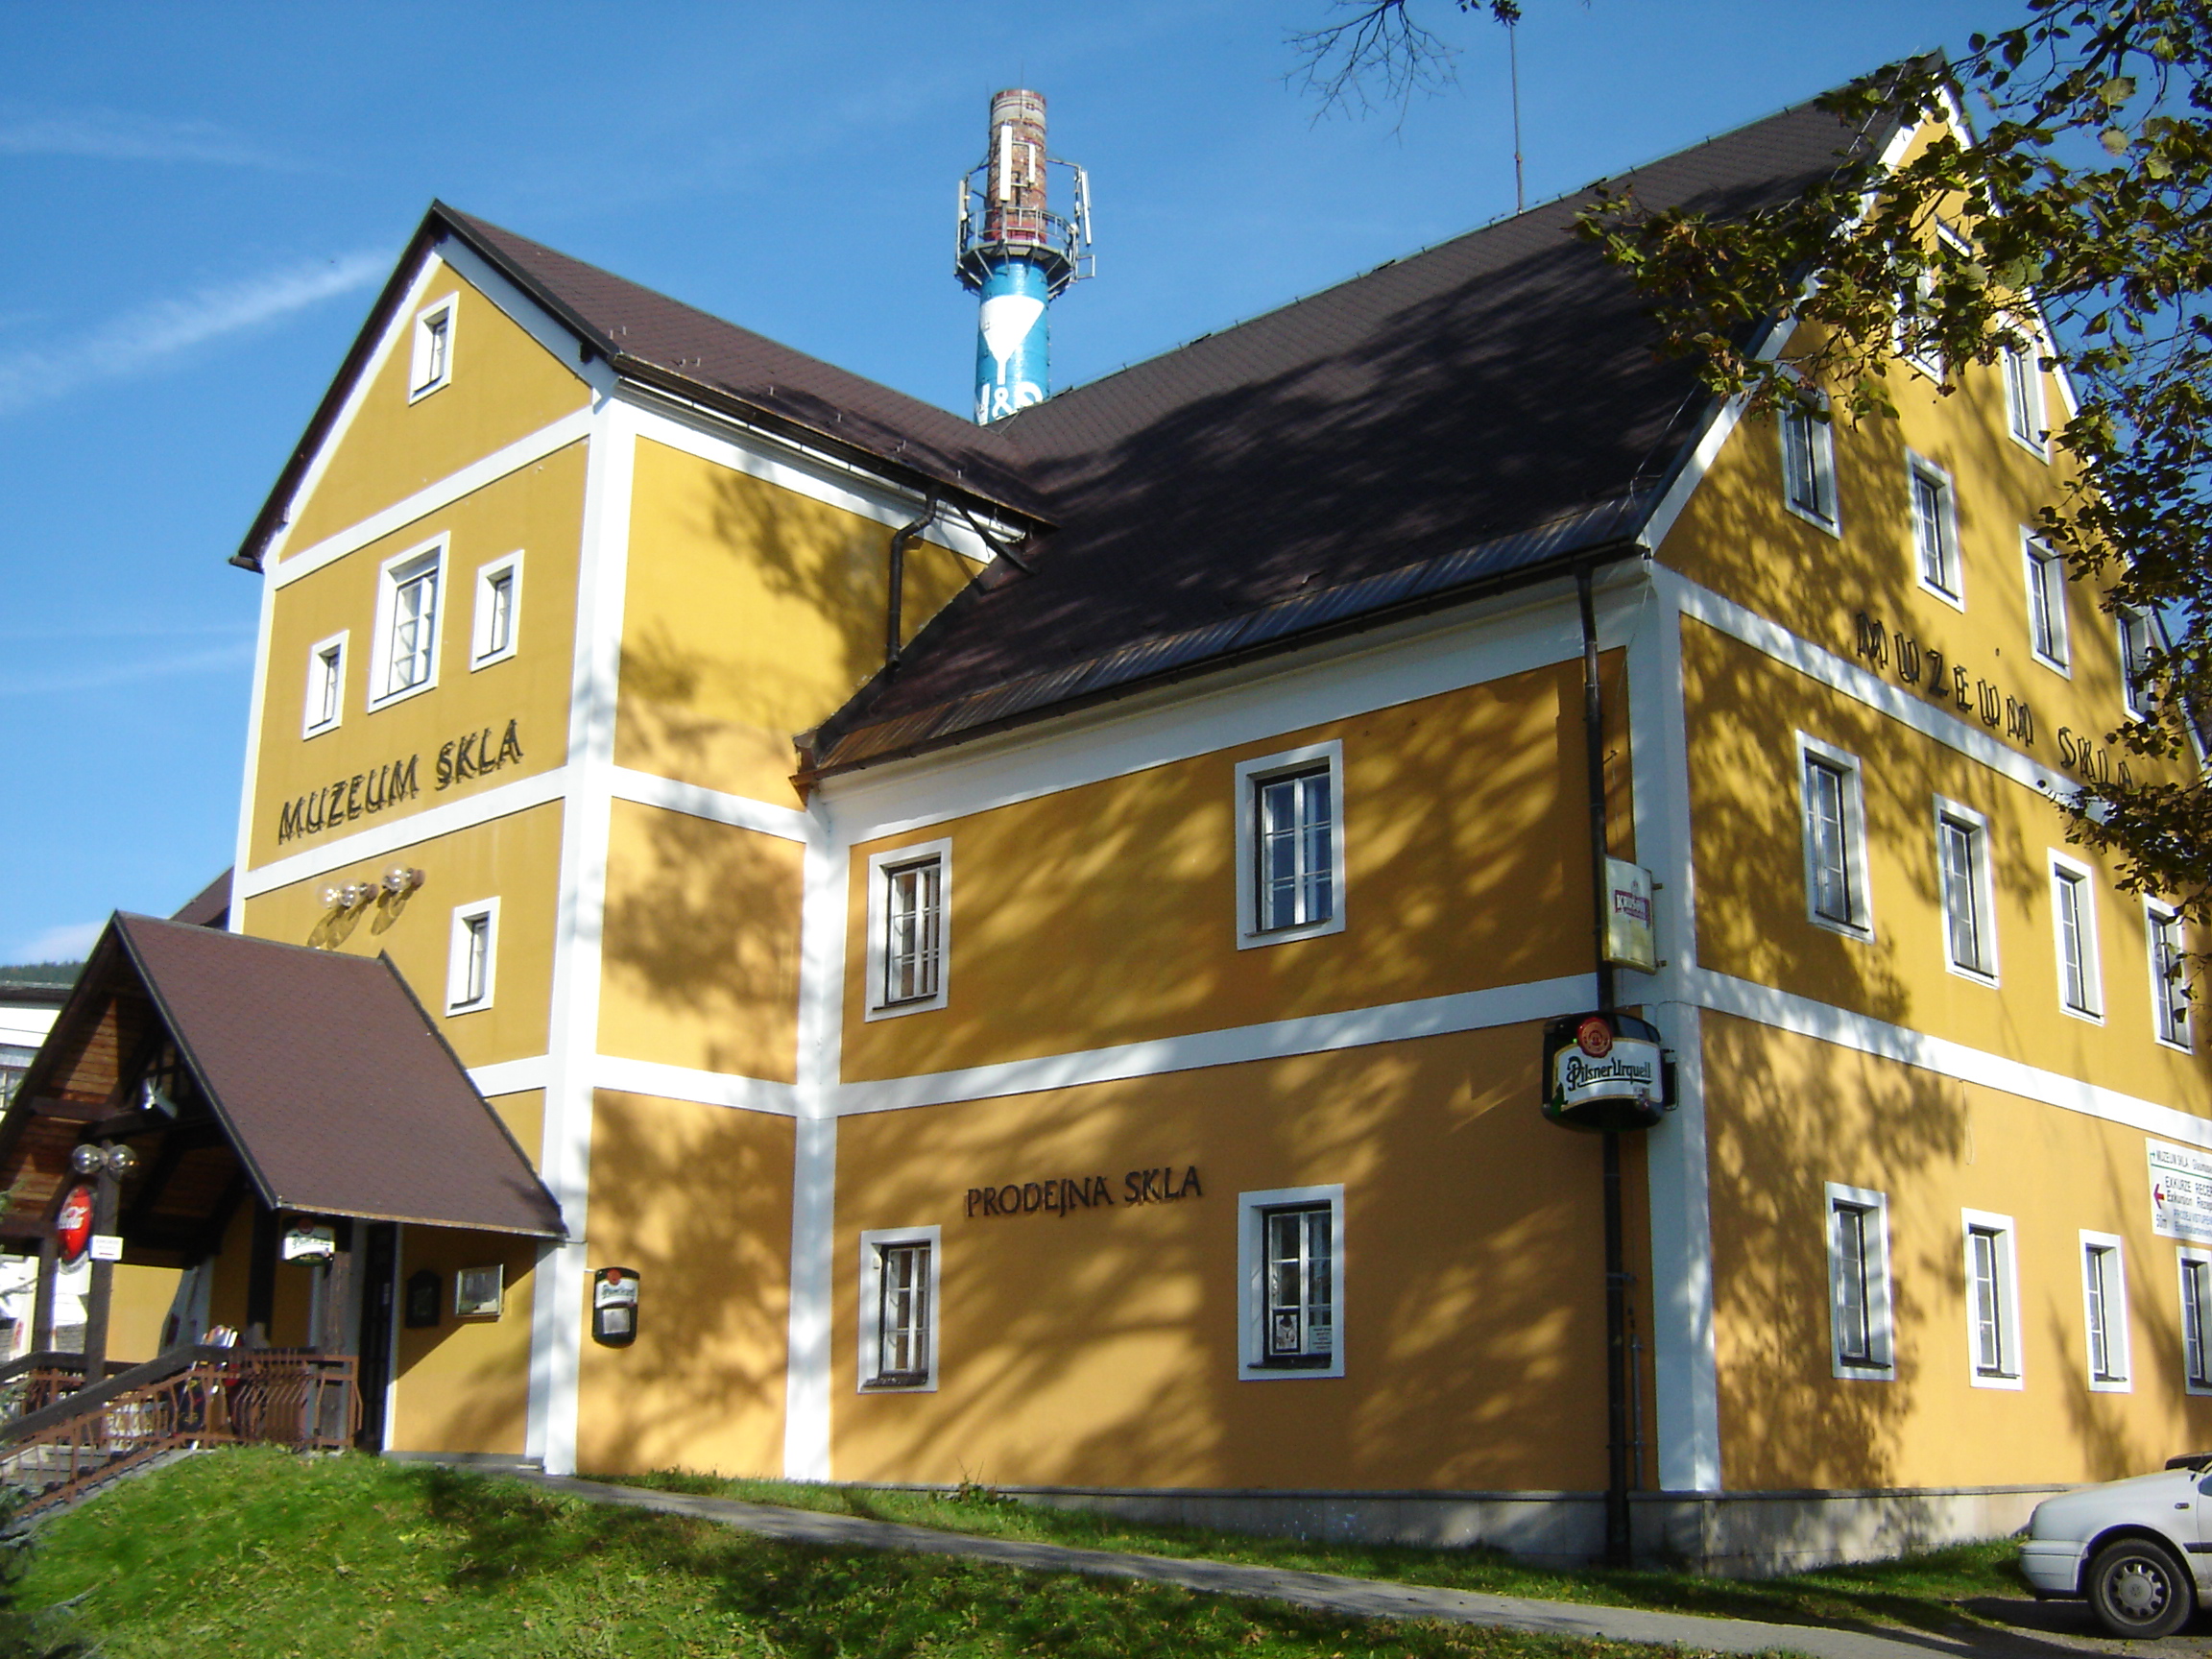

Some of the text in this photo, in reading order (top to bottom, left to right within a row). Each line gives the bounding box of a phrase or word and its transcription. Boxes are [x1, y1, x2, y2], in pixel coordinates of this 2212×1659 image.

[1856, 610, 2034, 748] MUZEUM
[278, 718, 524, 846] MUZEUM SKLA
[1566, 1055, 1651, 1092] Pilsner Urquell
[966, 1165, 1203, 1217] PRODEJNA SKLA
